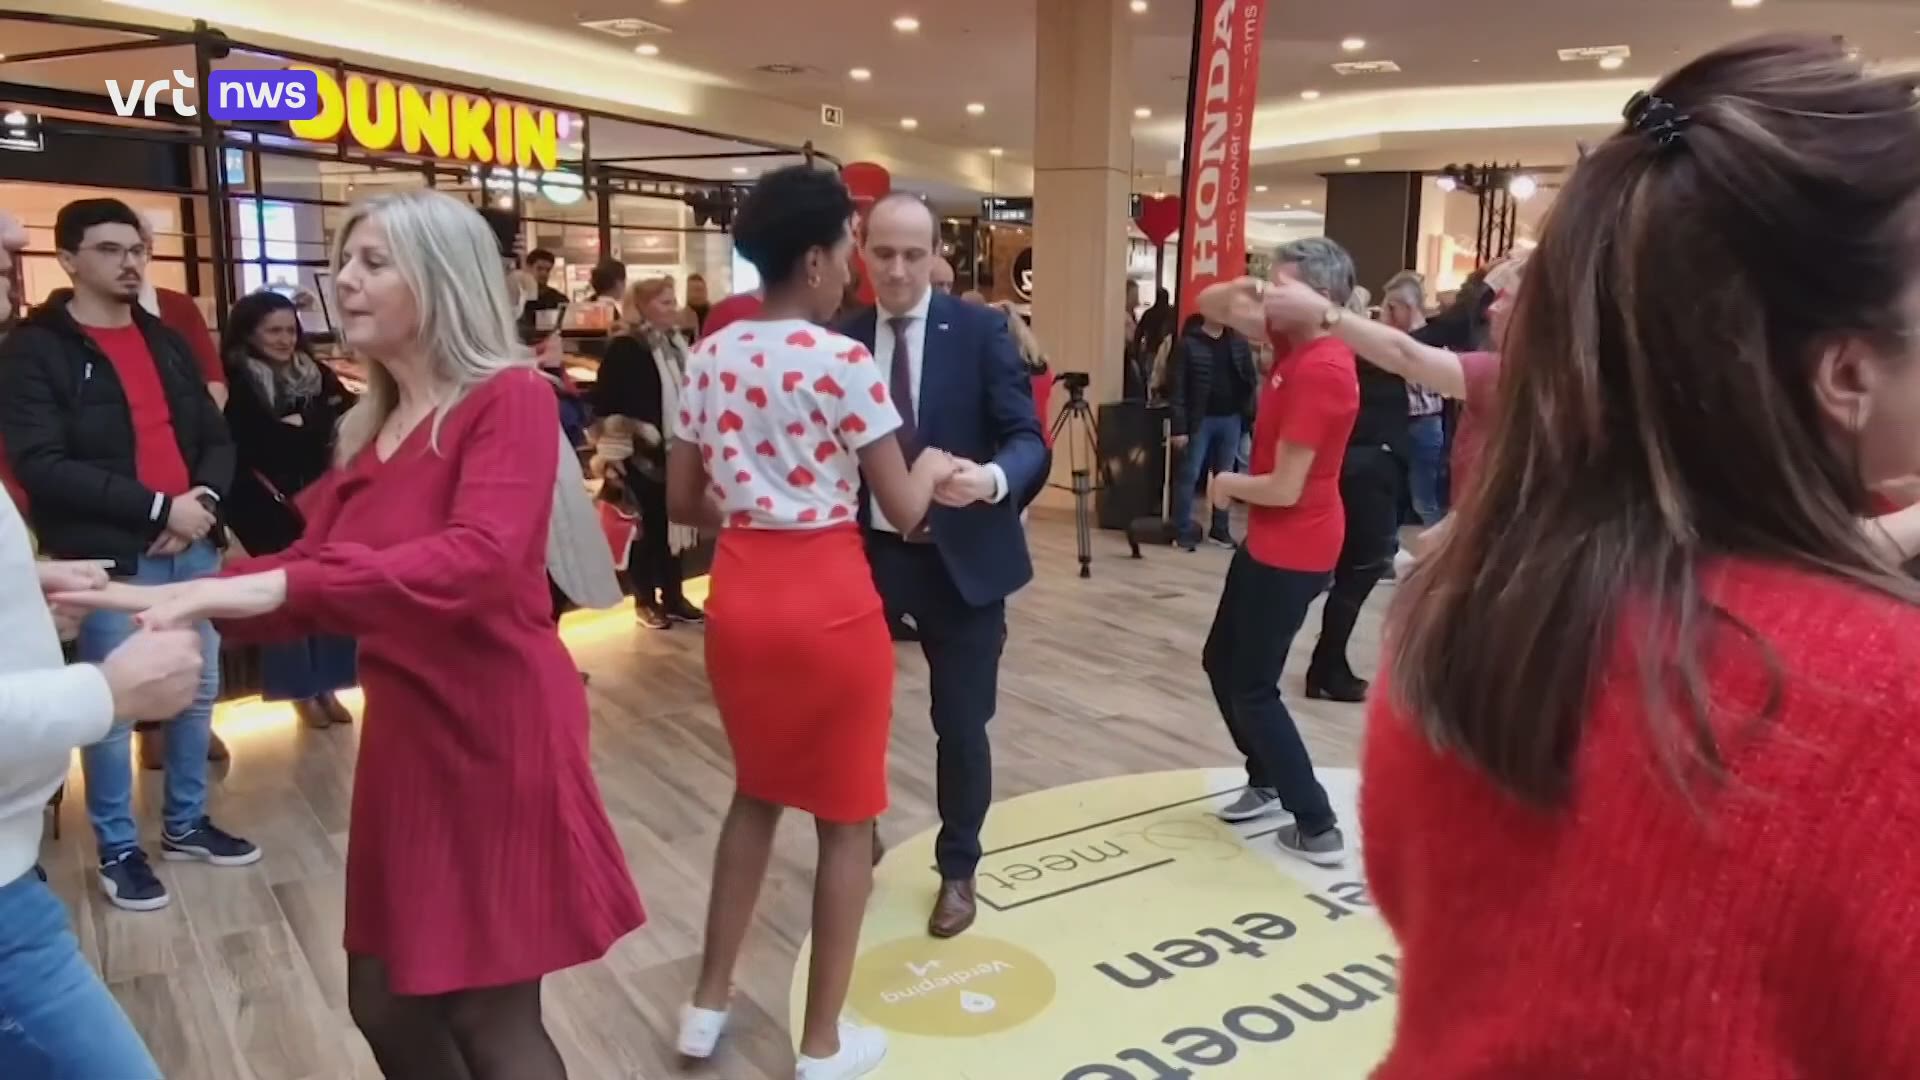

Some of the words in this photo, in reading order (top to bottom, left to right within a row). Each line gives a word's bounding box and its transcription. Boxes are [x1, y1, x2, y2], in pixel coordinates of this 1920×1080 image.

[1191, 0, 1236, 282] HONDA
[1227, 134, 1242, 206] Power
[978, 839, 1129, 890] meet
[879, 959, 1016, 1003] Verdieping
[1092, 911, 1298, 990] eten
